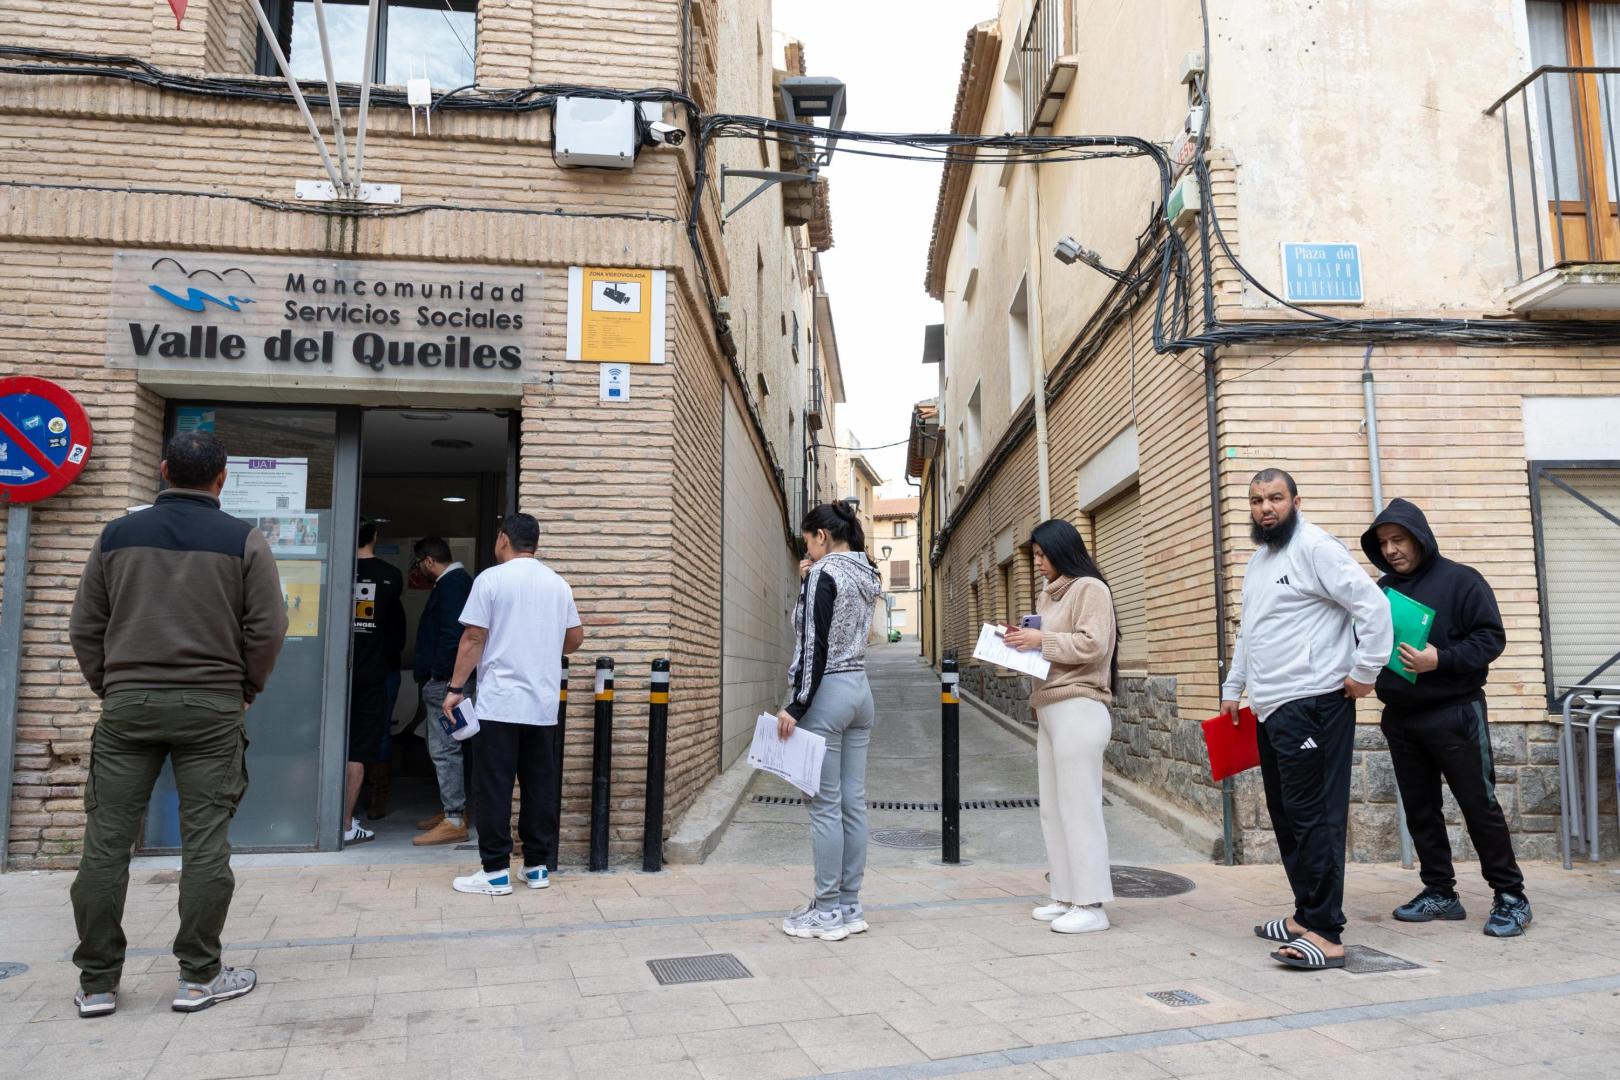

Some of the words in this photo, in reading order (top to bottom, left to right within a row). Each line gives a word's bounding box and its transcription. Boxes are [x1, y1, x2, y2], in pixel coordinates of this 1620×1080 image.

[1295, 247, 1326, 260] Plaza
[1336, 247, 1355, 260] del
[285, 273, 525, 302] Mancomunidad
[284, 300, 401, 326] Servicios
[416, 305, 524, 330] Sociales
[129, 322, 247, 360] Valle
[264, 329, 335, 364] del
[352, 332, 523, 373] Queiles
[252, 460, 273, 469] UAT
